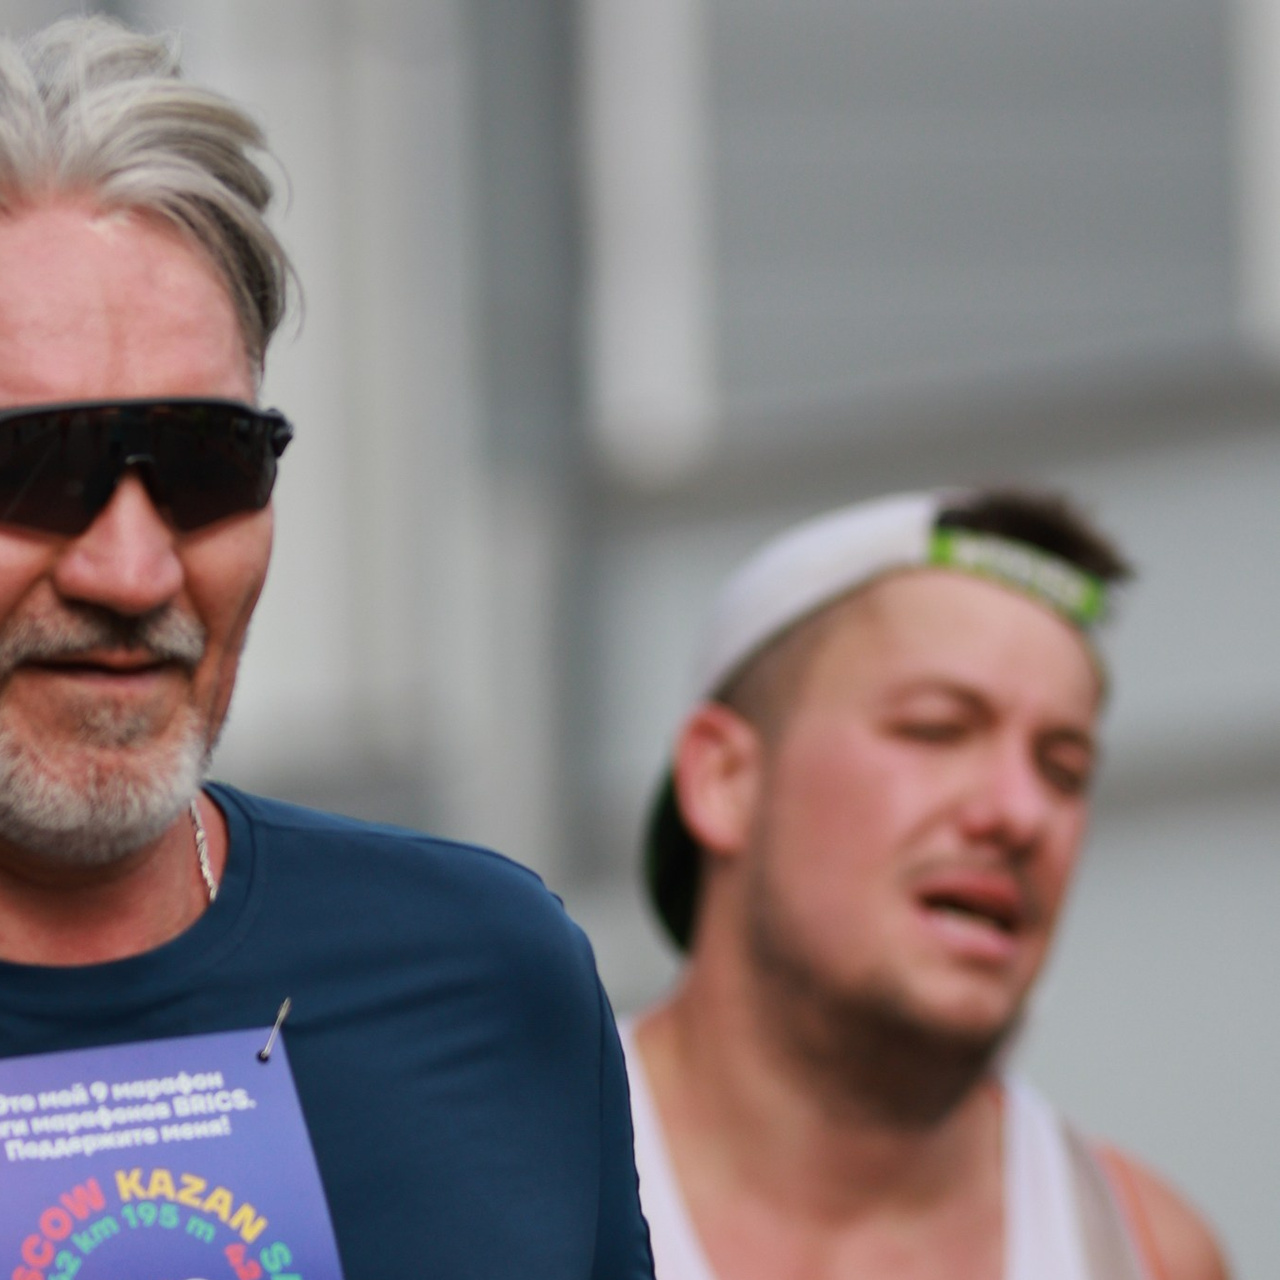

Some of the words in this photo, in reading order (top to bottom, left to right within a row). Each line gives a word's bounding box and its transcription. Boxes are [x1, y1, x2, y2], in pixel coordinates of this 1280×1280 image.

[38, 1082, 89, 1110] мой
[90, 1080, 108, 1102] 9
[111, 1071, 224, 1101] марафон
[5, 1127, 159, 1161] Поддержите
[161, 1114, 231, 1143] меня!
[29, 1102, 171, 1134] марафонов
[72, 1214, 120, 1255] km
[122, 1201, 180, 1229] 195
[186, 1215, 217, 1244] m
[114, 1167, 268, 1244] KAZAN
